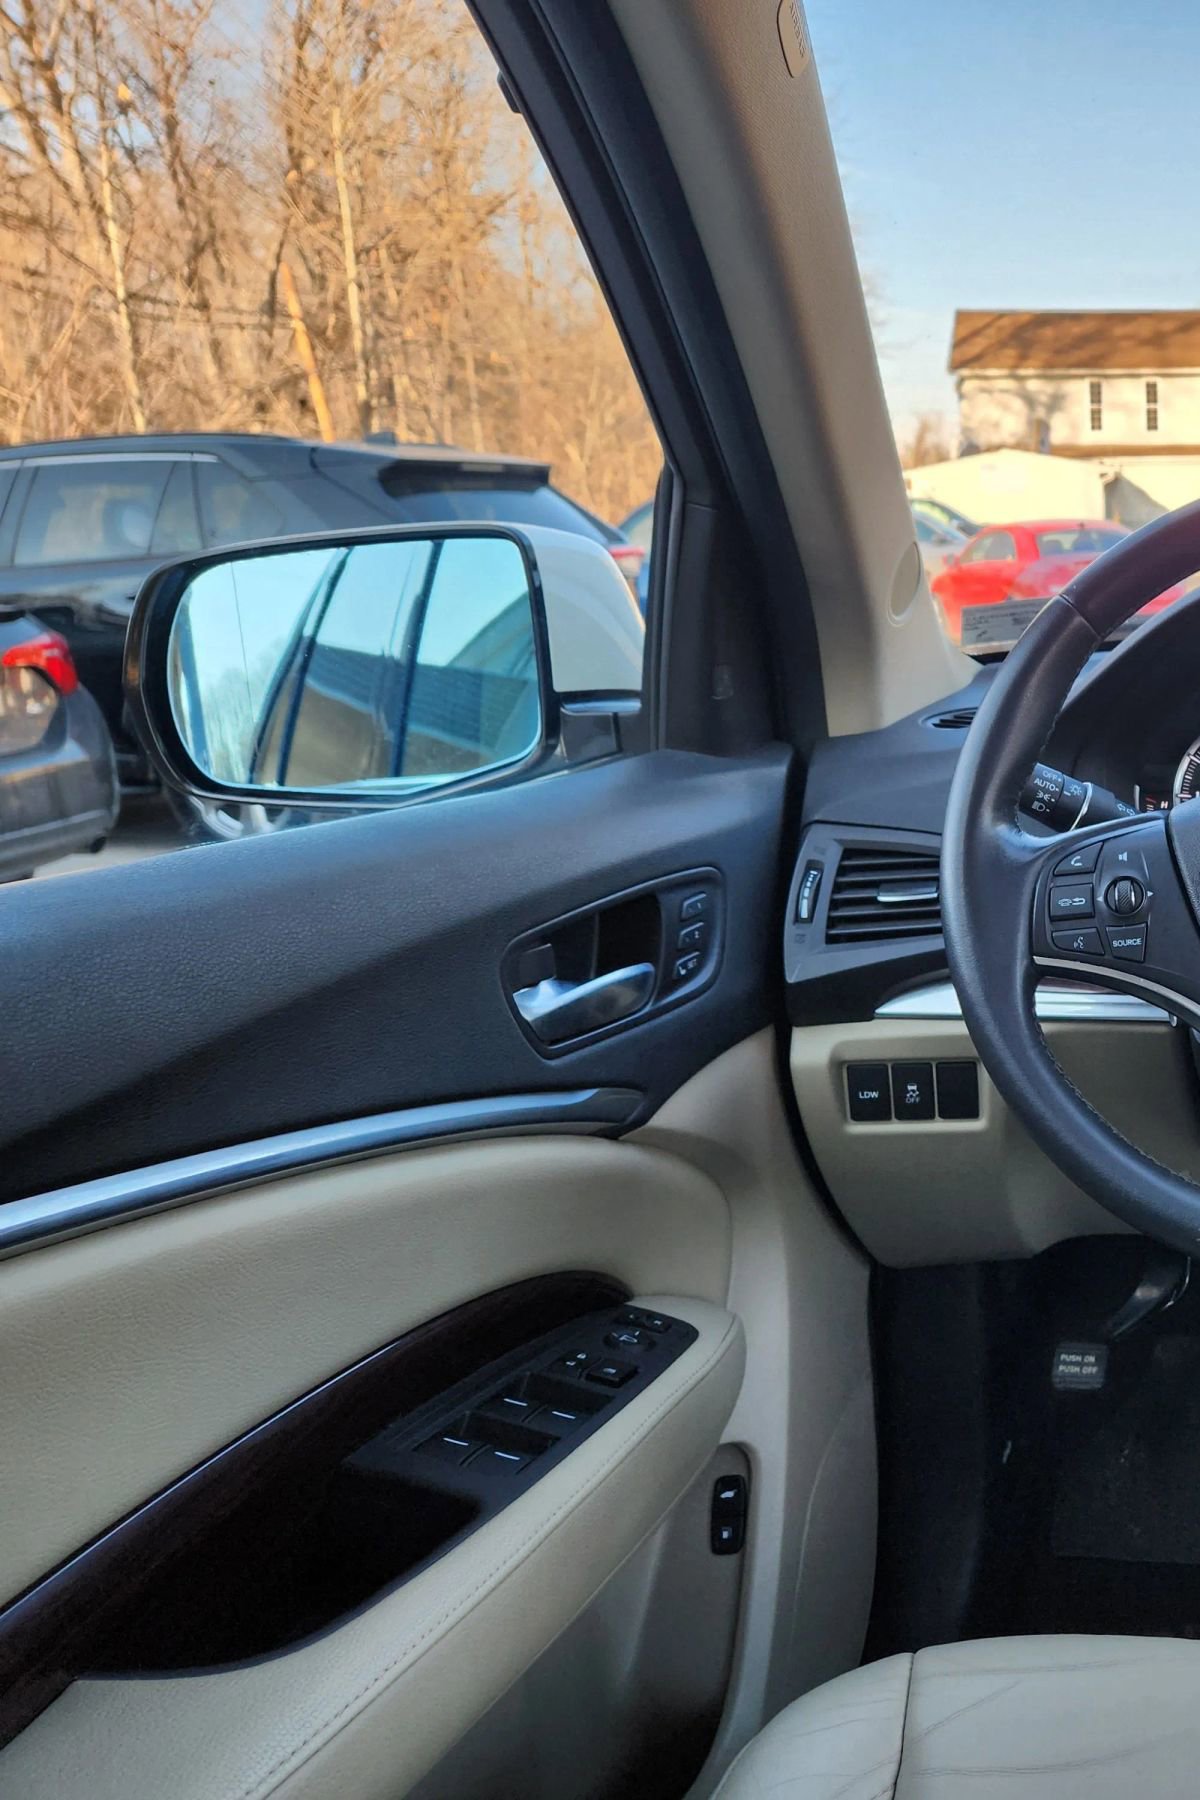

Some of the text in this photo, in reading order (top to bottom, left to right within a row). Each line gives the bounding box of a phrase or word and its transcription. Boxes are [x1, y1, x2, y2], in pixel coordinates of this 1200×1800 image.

[1033, 778, 1056, 792] AUTO
[1112, 937, 1143, 948] SOURCE
[859, 1091, 879, 1099] LDW
